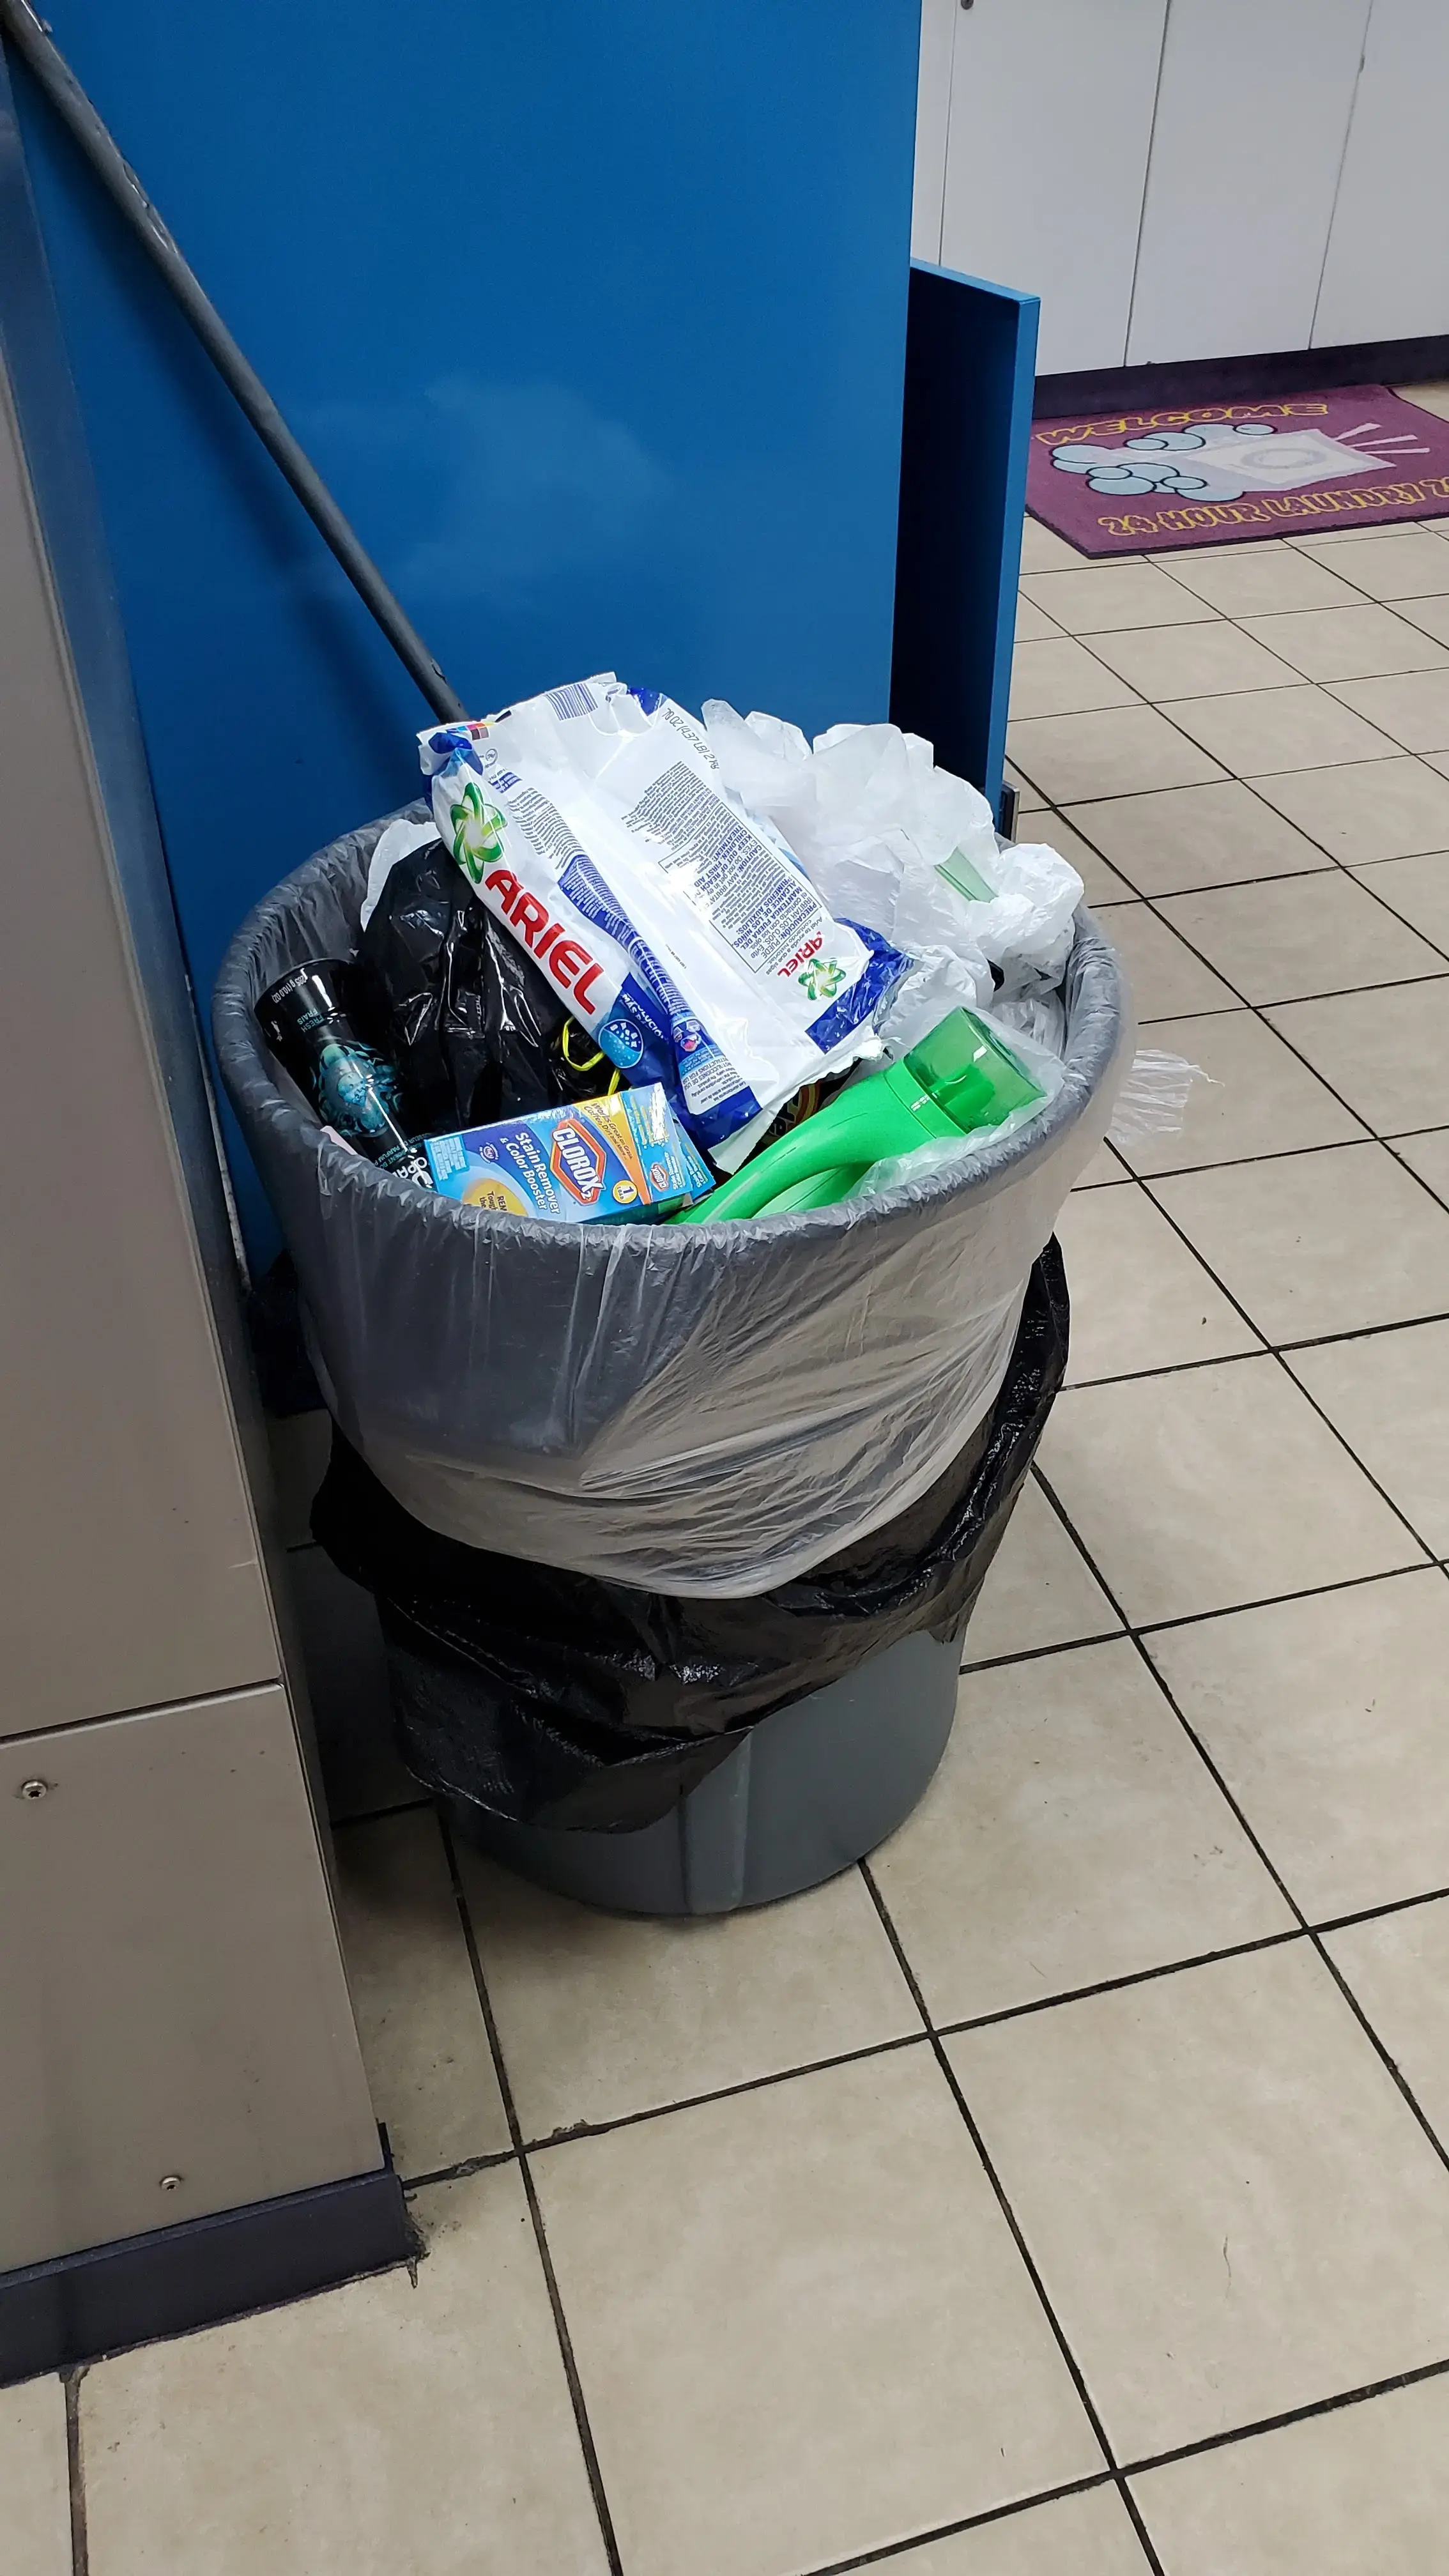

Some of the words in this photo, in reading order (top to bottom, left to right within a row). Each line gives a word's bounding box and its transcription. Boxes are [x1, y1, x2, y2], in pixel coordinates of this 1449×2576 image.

[1035, 404, 1329, 445] WELCOME
[1098, 514, 1159, 536] 24
[1156, 502, 1272, 531] HOUR
[1262, 482, 1427, 518] LAUNDRY
[1419, 476, 1449, 498] 2
[708, 824, 745, 862] TREATMENT:
[717, 829, 749, 861] CHILDREN.
[735, 834, 753, 851] KEEP
[740, 838, 758, 856] EYES.
[724, 850, 739, 864] OUT
[733, 855, 743, 865] Do
[734, 843, 763, 873] CAUTION:
[704, 860, 722, 878] FIRST
[718, 863, 729, 873] OF
[726, 864, 737, 875] not
[693, 875, 706, 889] AID
[700, 870, 721, 892] REACH
[717, 872, 729, 884] get
[725, 871, 739, 886] MAY
[761, 875, 793, 907] PRIMEROS
[769, 880, 798, 909] ALCANCE
[769, 885, 802, 920] MANTENGA
[778, 896, 802, 921] contacto
[790, 895, 813, 919] IRRITAR
[735, 905, 765, 935] AUXILIOS:
[762, 907, 772, 917] DE
[751, 916, 763, 929] LOS
[751, 918, 771, 939] FUERA
[769, 919, 780, 930] con
[778, 902, 816, 942] PRECAUCIÓN:
[778, 916, 792, 930] LOS
[809, 916, 824, 930] Ariel
[731, 927, 753, 950] NIÑOS.
[761, 929, 770, 939] los
[762, 927, 781, 946] OJOS.
[788, 919, 812, 944] contando
[485, 870, 604, 1015] ARIEL
[740, 937, 753, 951] DEL
[748, 937, 762, 951] ojos.
[760, 938, 781, 958] PUEDE
[790, 932, 806, 950] ayuda
[749, 944, 765, 959] Evite
[776, 931, 825, 977] ARIEL
[765, 961, 779, 976] sigas
[277, 981, 293, 997] (10.0
[293, 974, 307, 986] 285
[295, 1007, 319, 1025] FRAIS
[299, 1014, 325, 1032] FRESH
[689, 1071, 698, 1080] FOR
[591, 1102, 611, 1123] Works
[608, 1123, 622, 1139] Great
[601, 1124, 613, 1136] Dirt
[505, 1140, 529, 1170] Color
[523, 1169, 549, 1210] Booster
[514, 1131, 542, 1163] Stain
[533, 1162, 562, 1215] Remover
[616, 1186, 625, 1200] LOAD
[622, 1185, 634, 1195] 1
[478, 1197, 487, 1208] the
